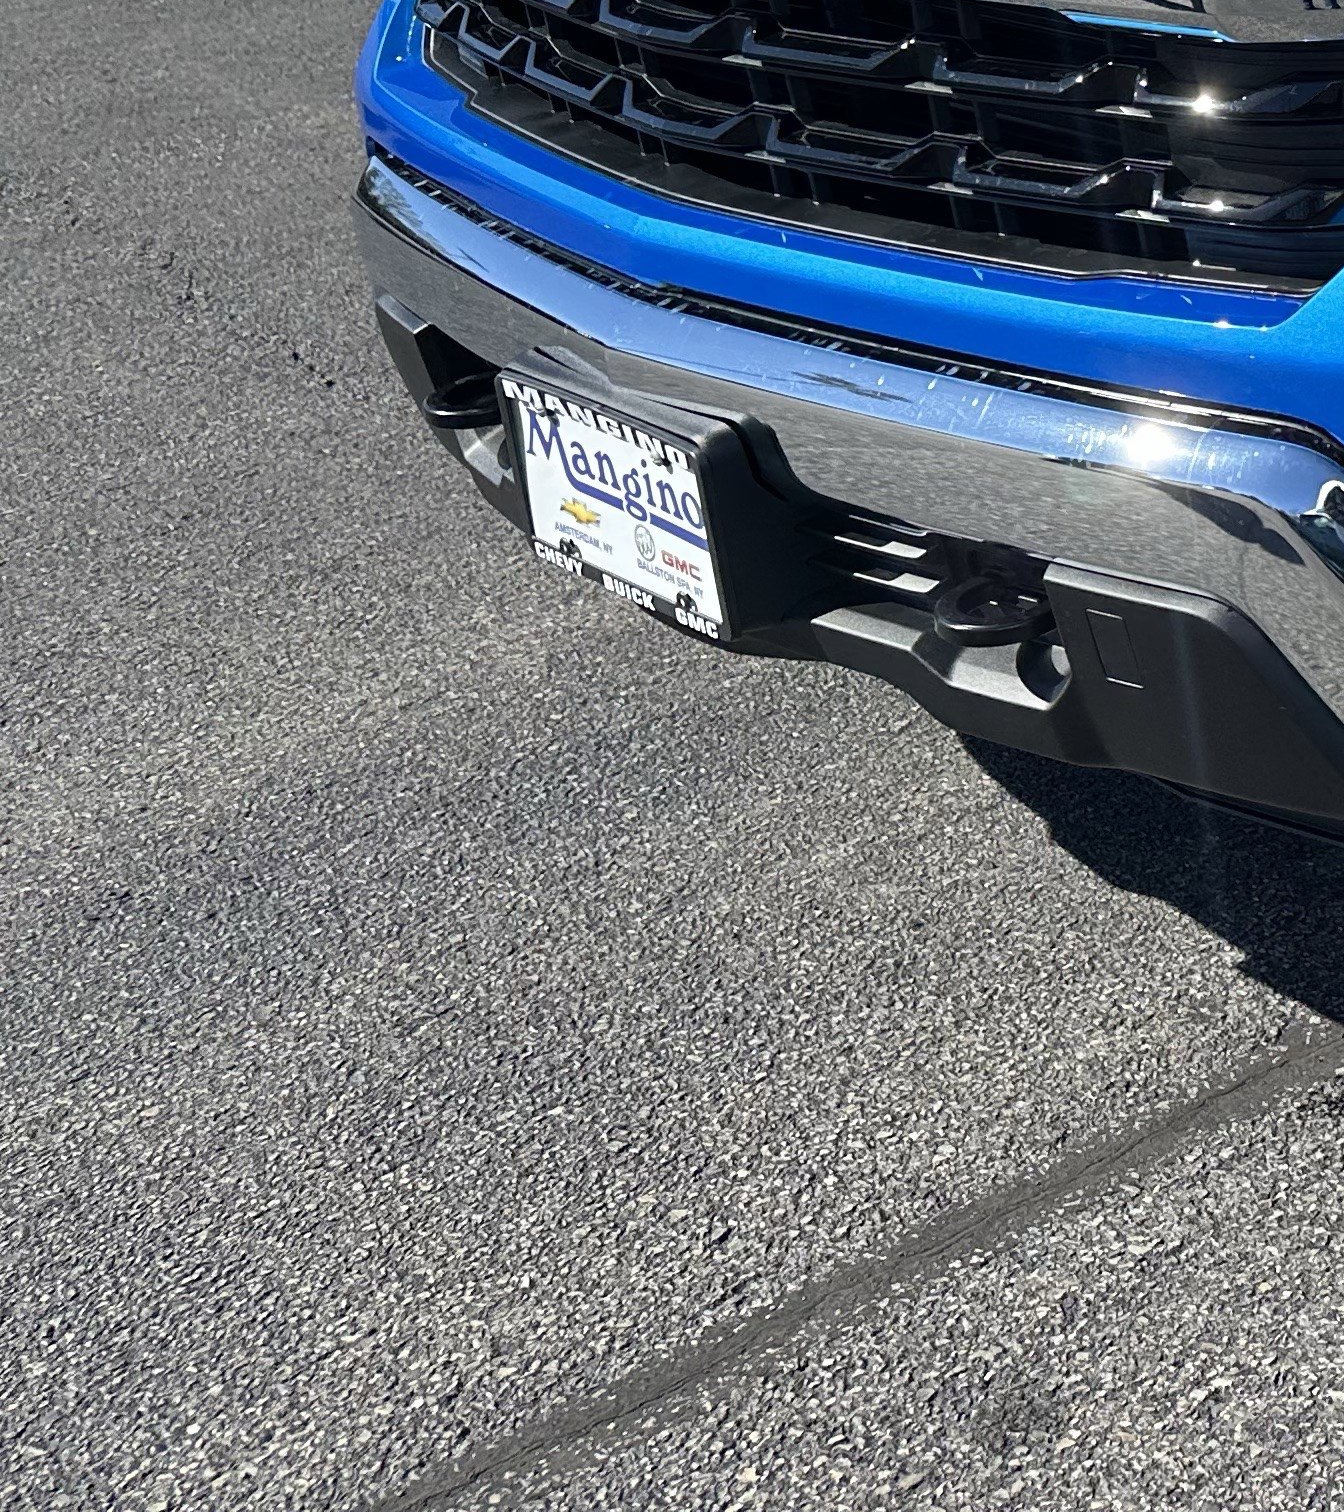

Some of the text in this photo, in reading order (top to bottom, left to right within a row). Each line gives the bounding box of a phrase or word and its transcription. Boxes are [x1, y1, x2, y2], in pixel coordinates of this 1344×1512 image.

[501, 379, 693, 473] MANGINO
[526, 408, 703, 528] Mangino
[534, 541, 719, 639] CHEVY BUICK GMC
[636, 557, 675, 585] BALLSTON
[660, 549, 702, 582] GMC
